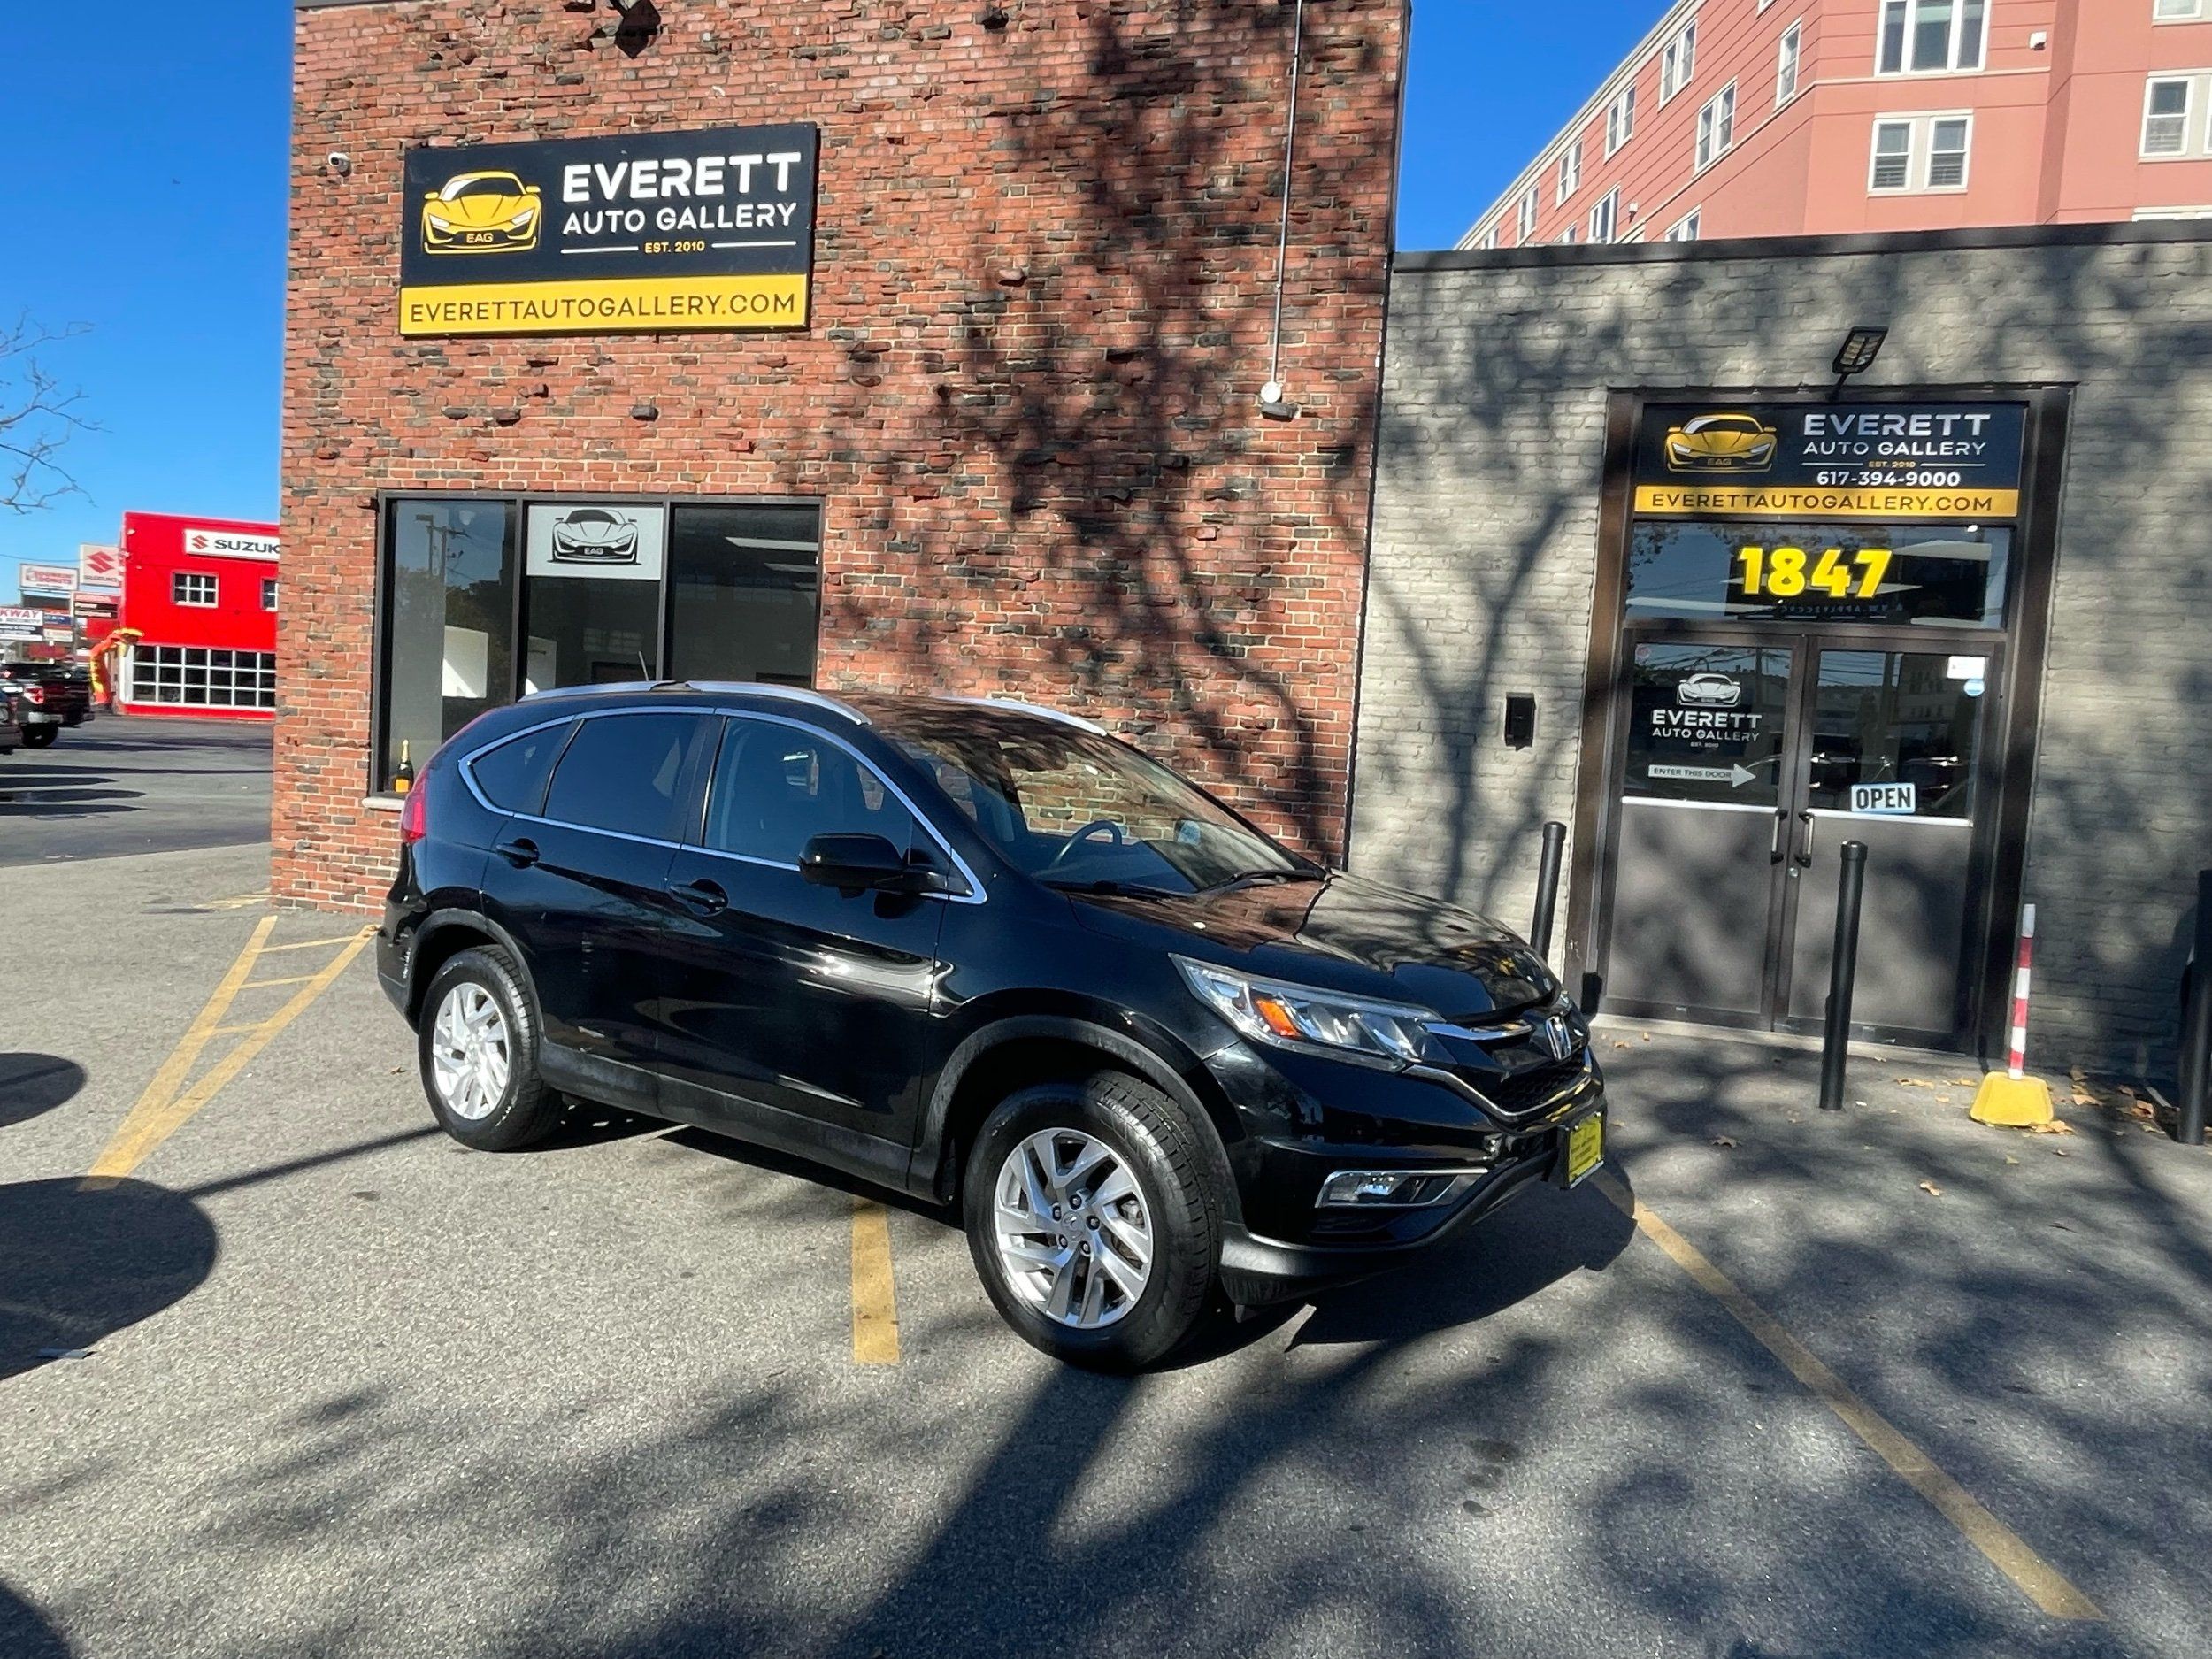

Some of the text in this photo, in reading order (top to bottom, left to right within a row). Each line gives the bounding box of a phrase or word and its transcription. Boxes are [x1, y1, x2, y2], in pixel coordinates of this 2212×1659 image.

[563, 152, 801, 203] EVERETT
[562, 202, 797, 235] AUTO GALLERY
[466, 233, 494, 243] EAG
[645, 240, 705, 253] EST. 2010
[411, 293, 795, 322] EVERETTAUTOGALLERY.COM
[1803, 413, 1991, 436] EVERETT
[1802, 442, 1986, 456] AUTO GALLERY
[1816, 471, 1961, 487] 617-394-9000
[1652, 494, 1993, 511] EVERETTAUTOGALLERY.COM
[214, 539, 280, 554] SUZUK
[1737, 546, 1893, 599] 1847
[0, 609, 39, 618] KWAY
[1652, 710, 1763, 729] EVERETT
[1652, 727, 1760, 741] AUTO GALLERY
[1705, 770, 1732, 779] DOOR
[1855, 787, 1912, 809] OPEN
